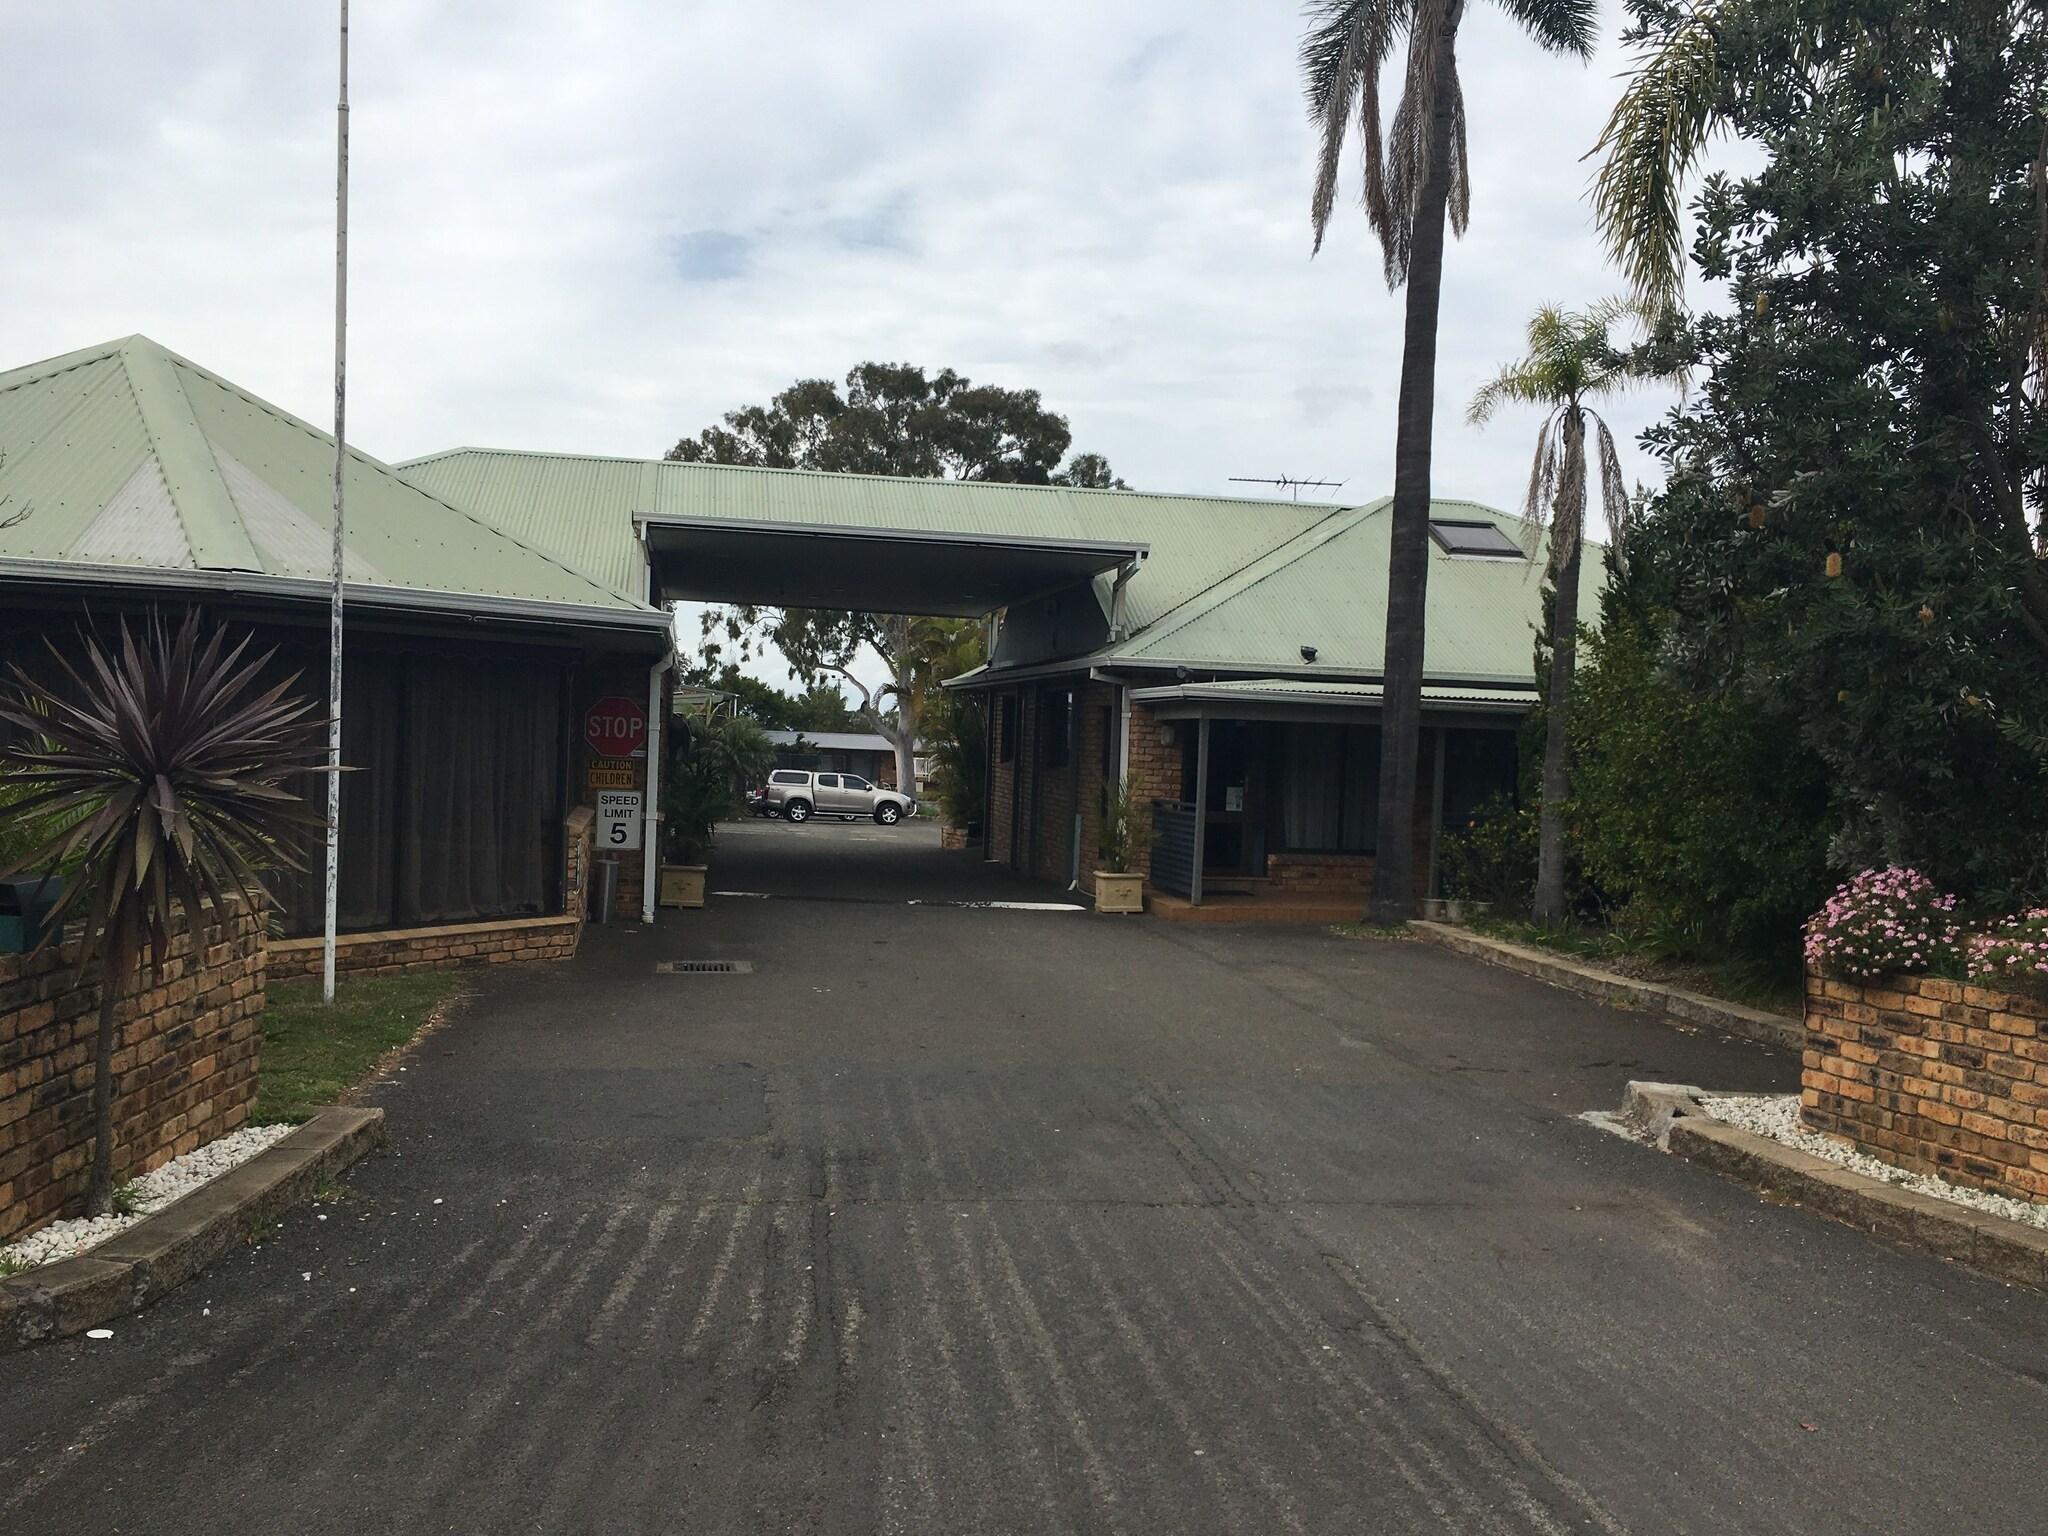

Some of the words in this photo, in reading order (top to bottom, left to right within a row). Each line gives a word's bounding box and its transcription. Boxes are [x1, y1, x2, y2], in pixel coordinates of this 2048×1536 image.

[589, 716, 643, 738] STOP
[591, 760, 632, 770] CAUTION
[590, 771, 632, 785] CHILDREN
[601, 795, 639, 805] SPEED
[604, 809, 634, 818] LIMIT
[610, 823, 627, 844] 5
